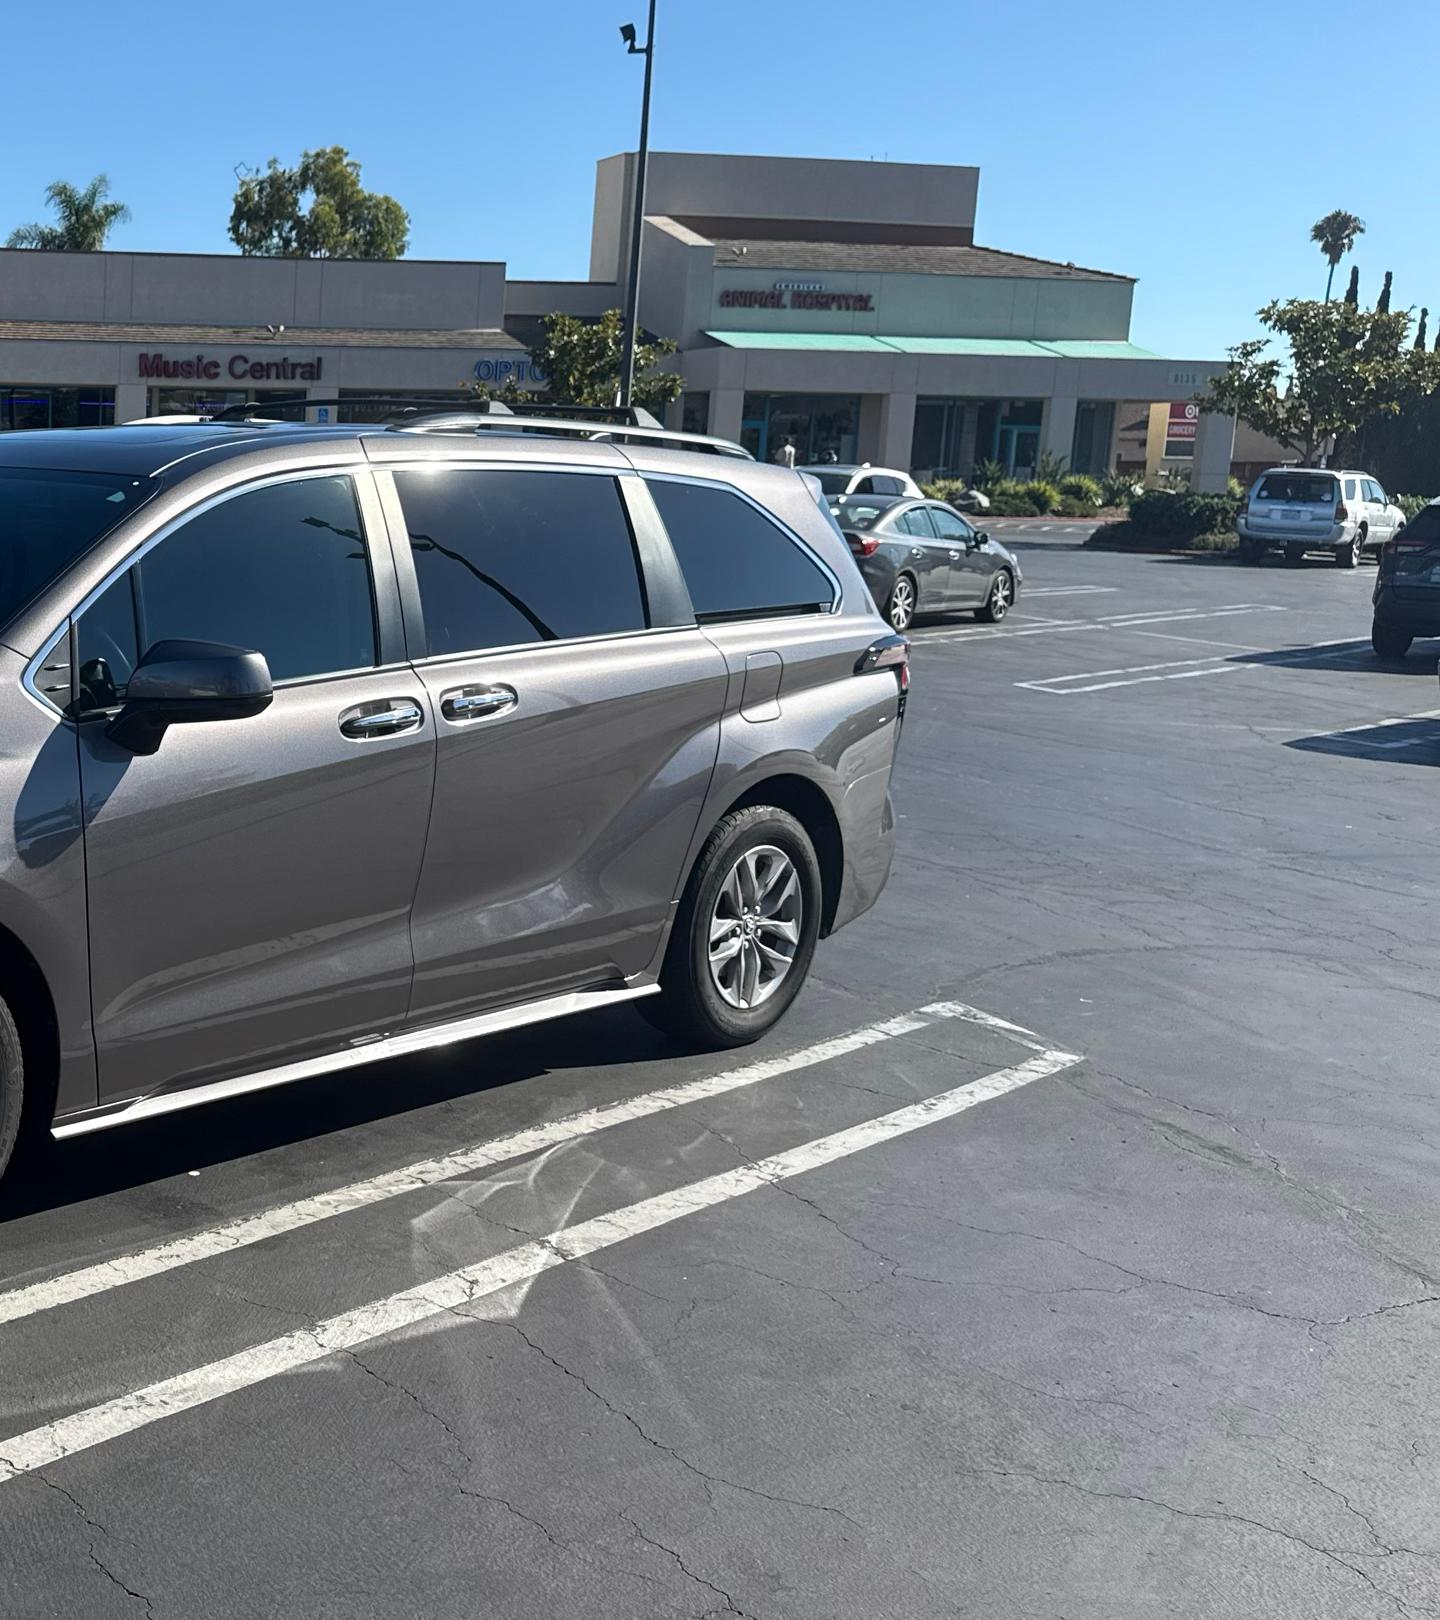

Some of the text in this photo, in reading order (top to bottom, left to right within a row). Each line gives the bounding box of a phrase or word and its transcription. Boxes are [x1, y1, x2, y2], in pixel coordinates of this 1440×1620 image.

[720, 290, 875, 312] ANIMAL HOSPITAL
[138, 353, 323, 381] Music Central
